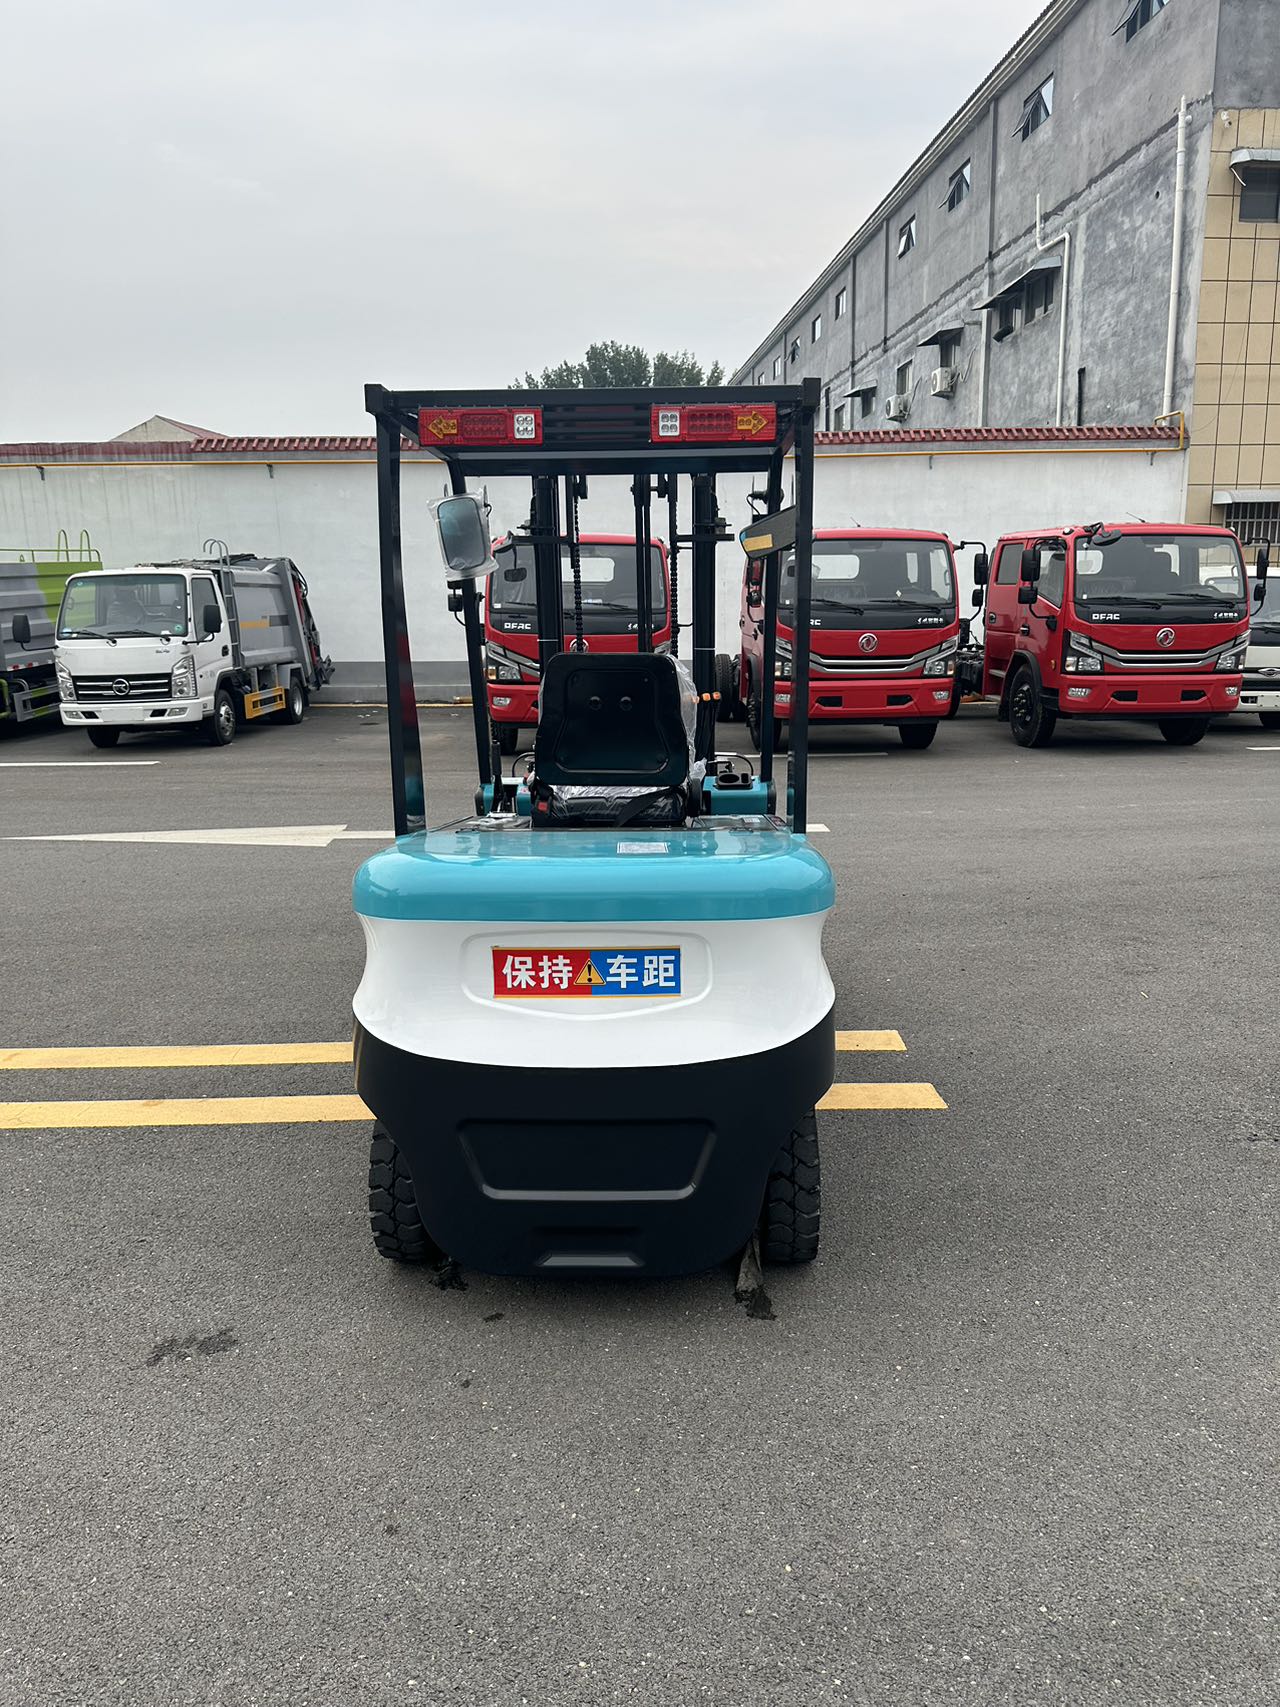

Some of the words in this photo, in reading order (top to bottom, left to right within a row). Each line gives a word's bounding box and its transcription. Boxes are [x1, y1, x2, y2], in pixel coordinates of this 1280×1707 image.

[1092, 613, 1120, 621] DFAC
[502, 955, 573, 989] 保持
[606, 955, 676, 989] 车距
